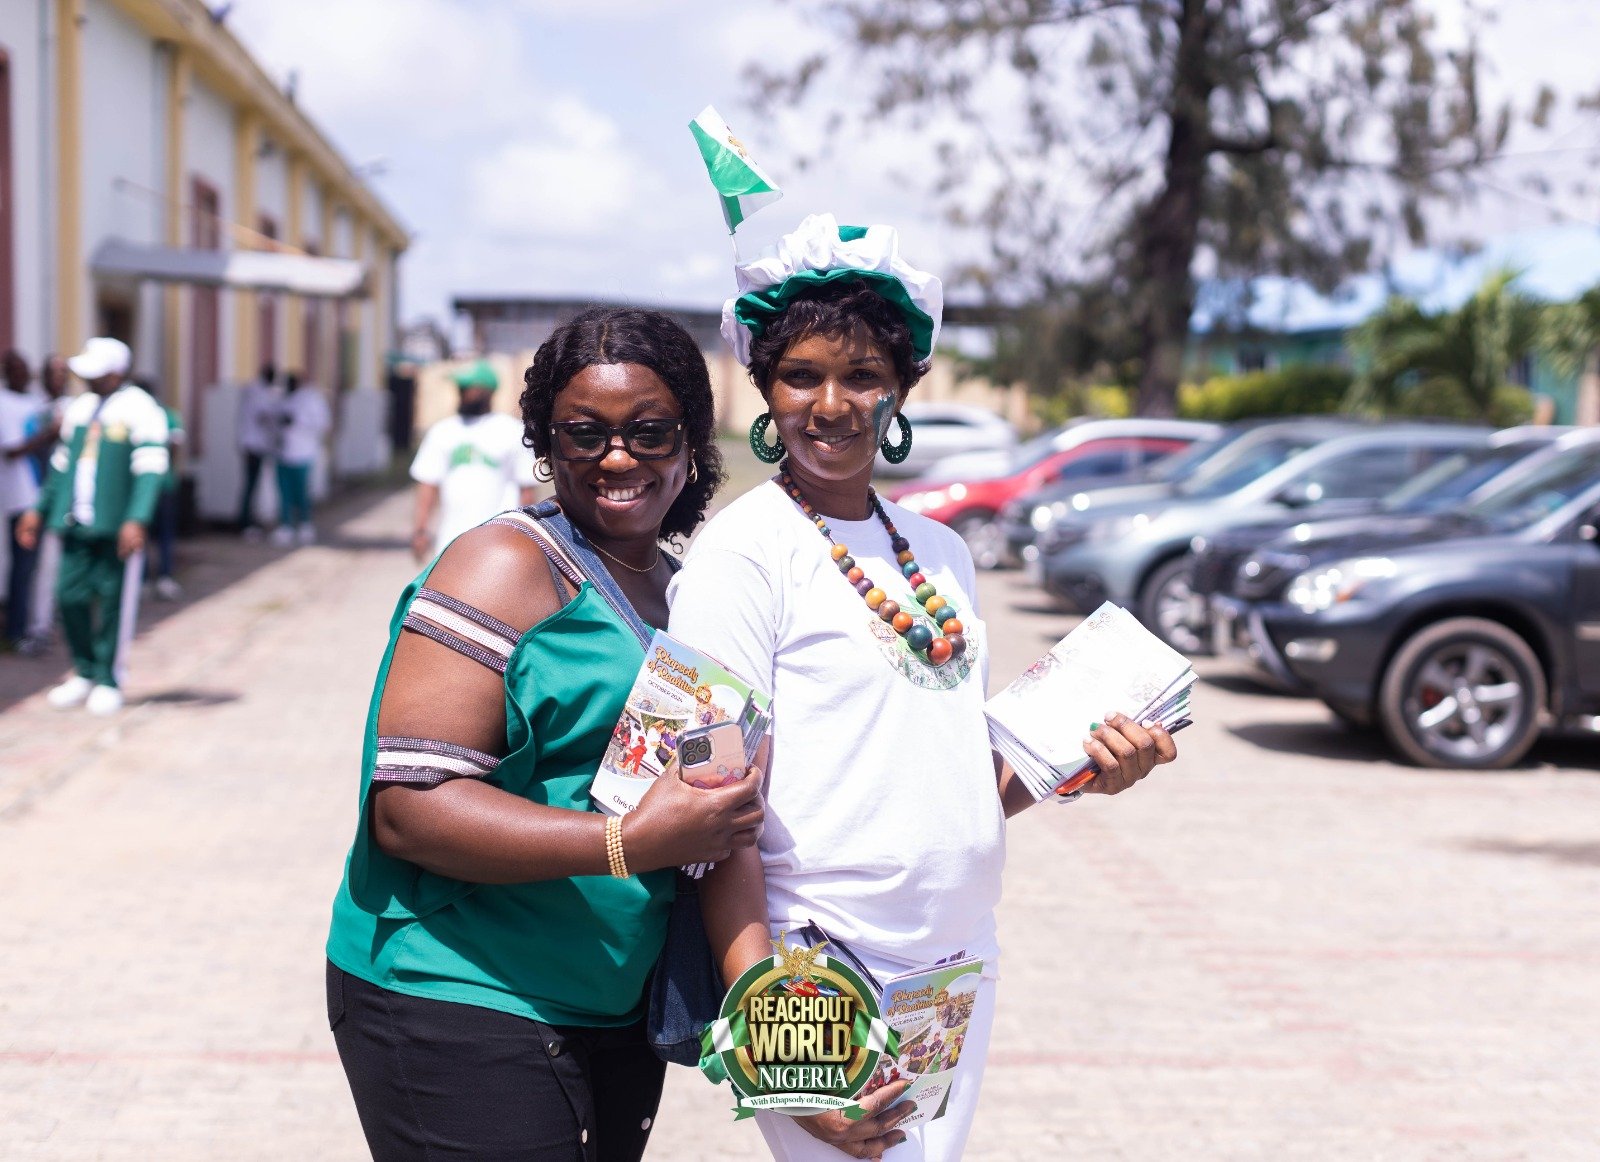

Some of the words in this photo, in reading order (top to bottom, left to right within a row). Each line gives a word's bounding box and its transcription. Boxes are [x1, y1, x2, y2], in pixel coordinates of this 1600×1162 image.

[647, 659, 659, 673] of
[656, 664, 695, 696] Realities
[655, 645, 699, 684] Rhapsody
[648, 679, 671, 695] OCTOBER
[612, 795, 628, 809] Chris
